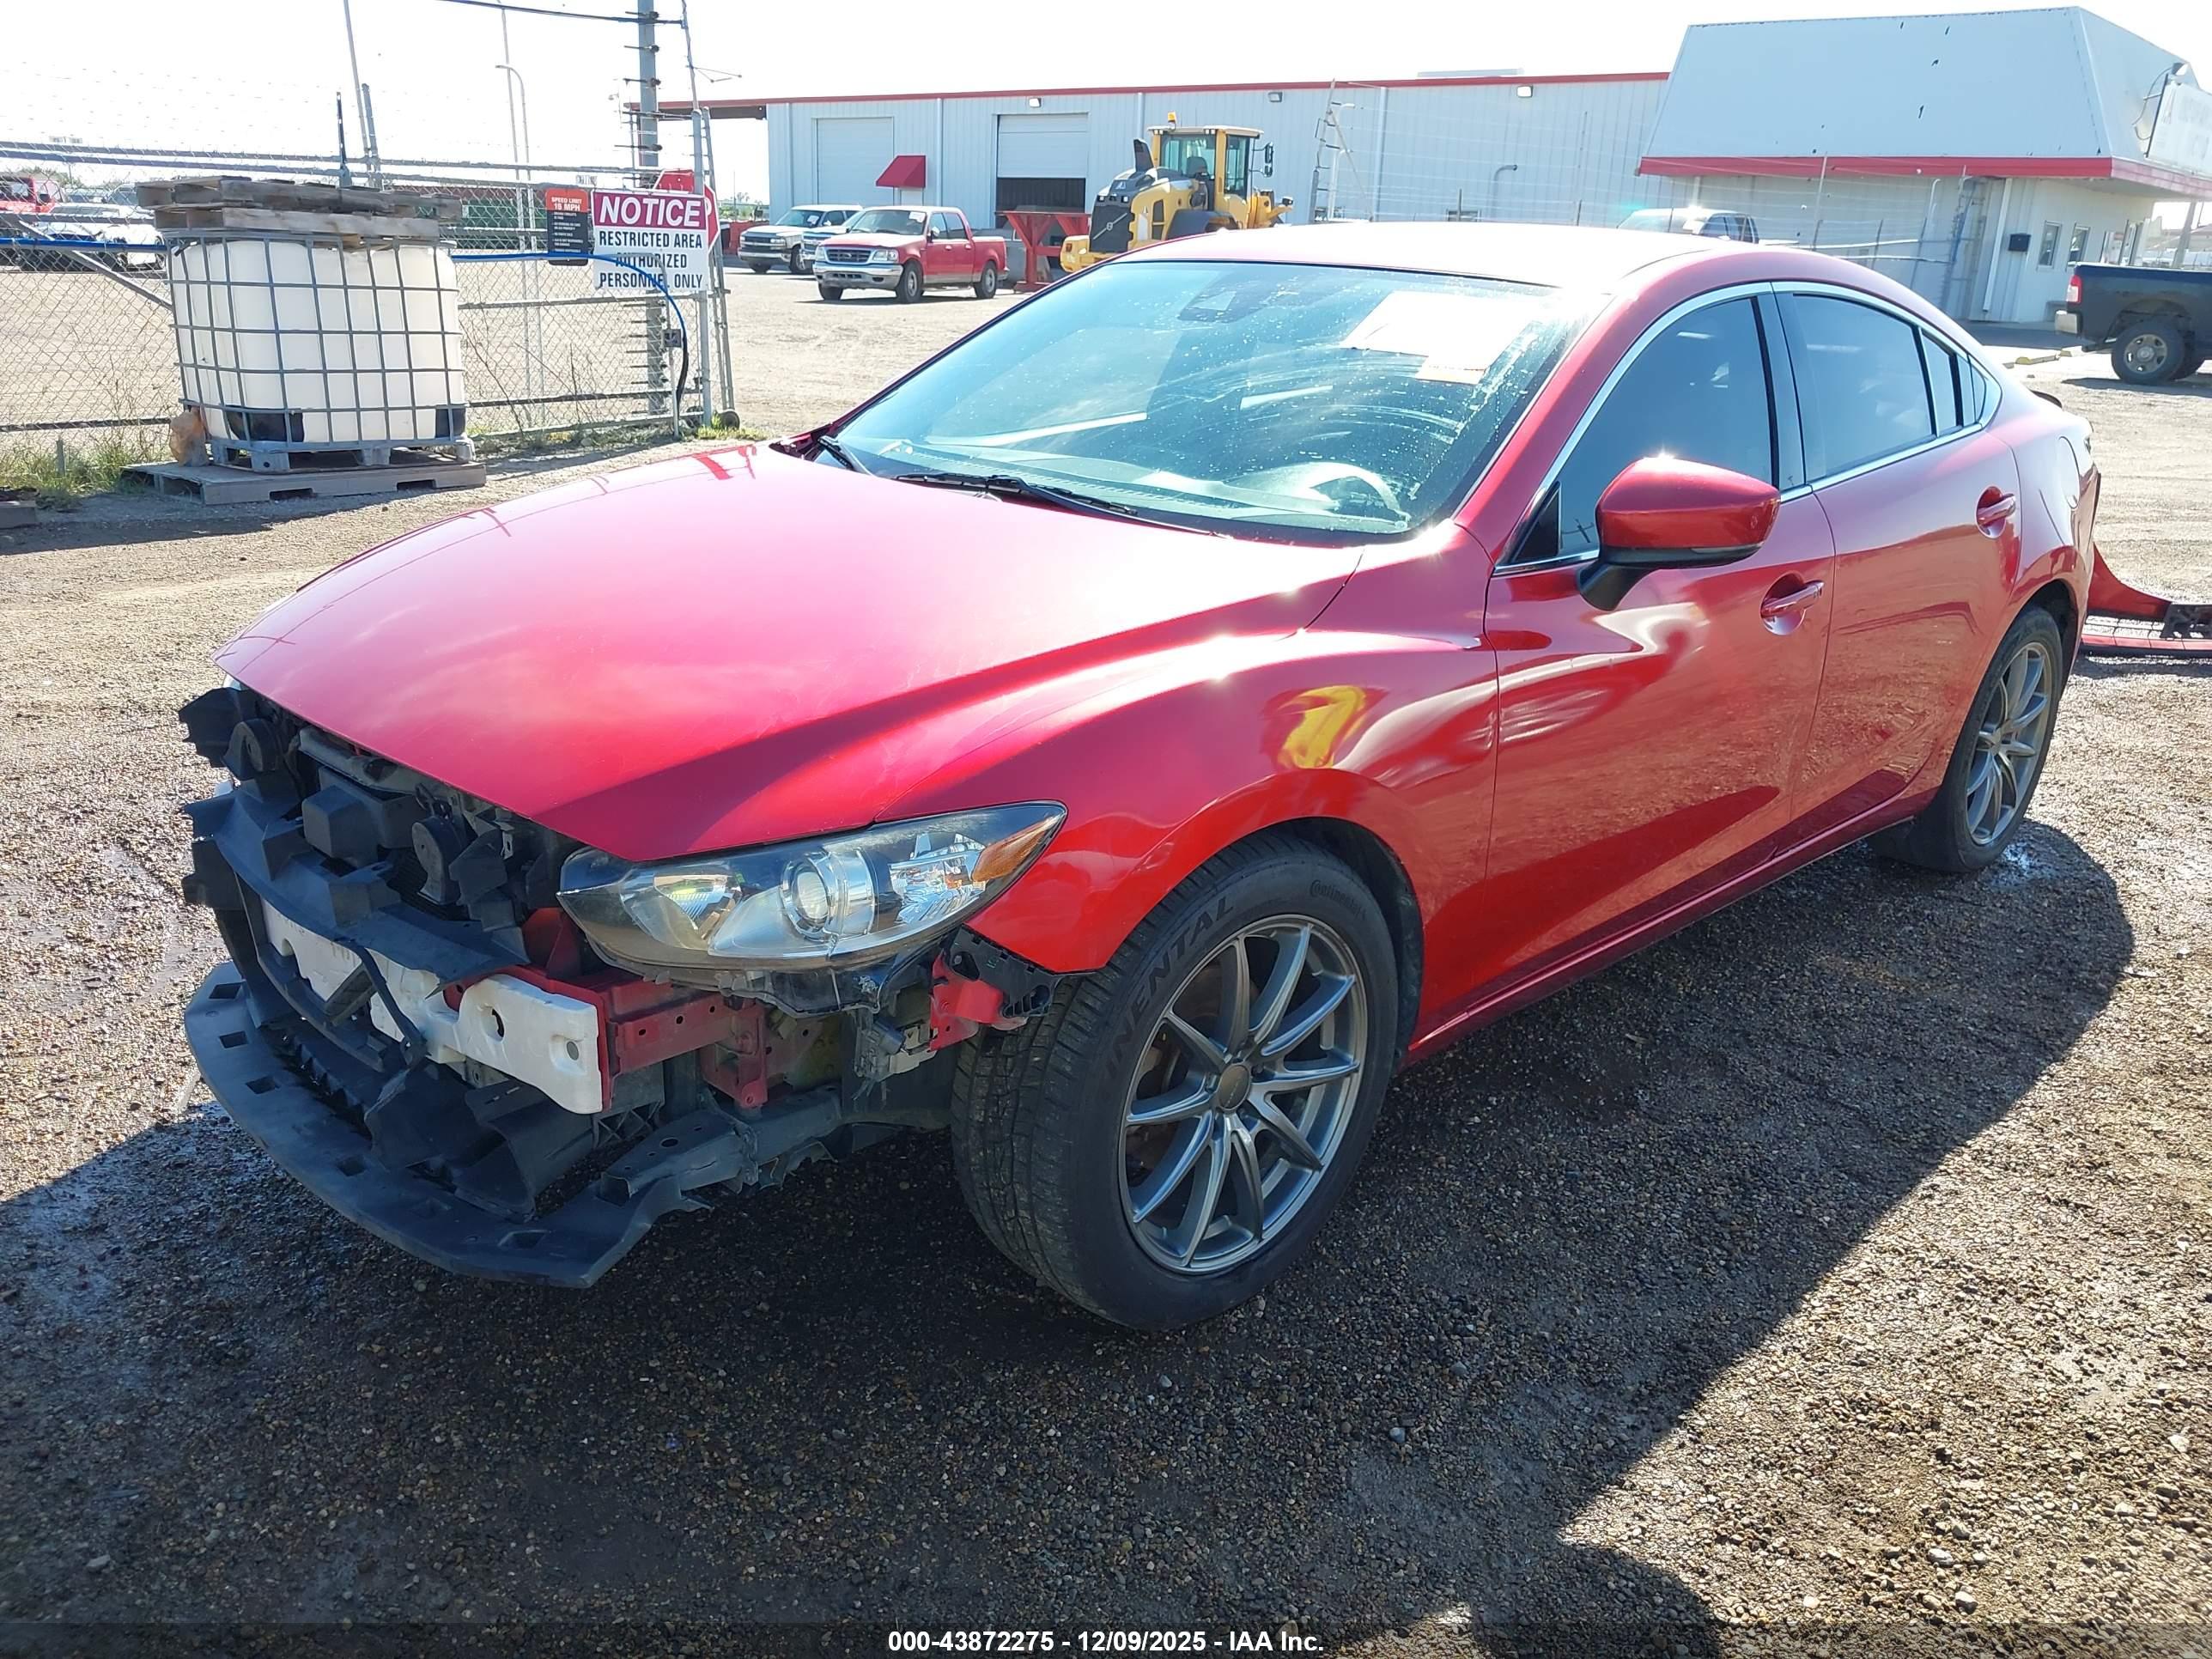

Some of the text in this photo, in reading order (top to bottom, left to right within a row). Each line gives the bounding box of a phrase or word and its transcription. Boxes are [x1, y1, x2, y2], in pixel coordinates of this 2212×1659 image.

[563, 203, 580, 211] MPH
[599, 196, 702, 228] NOTICE
[599, 230, 702, 248] RESTRICTED AREA
[600, 272, 702, 289] PERSONNE ONLY
